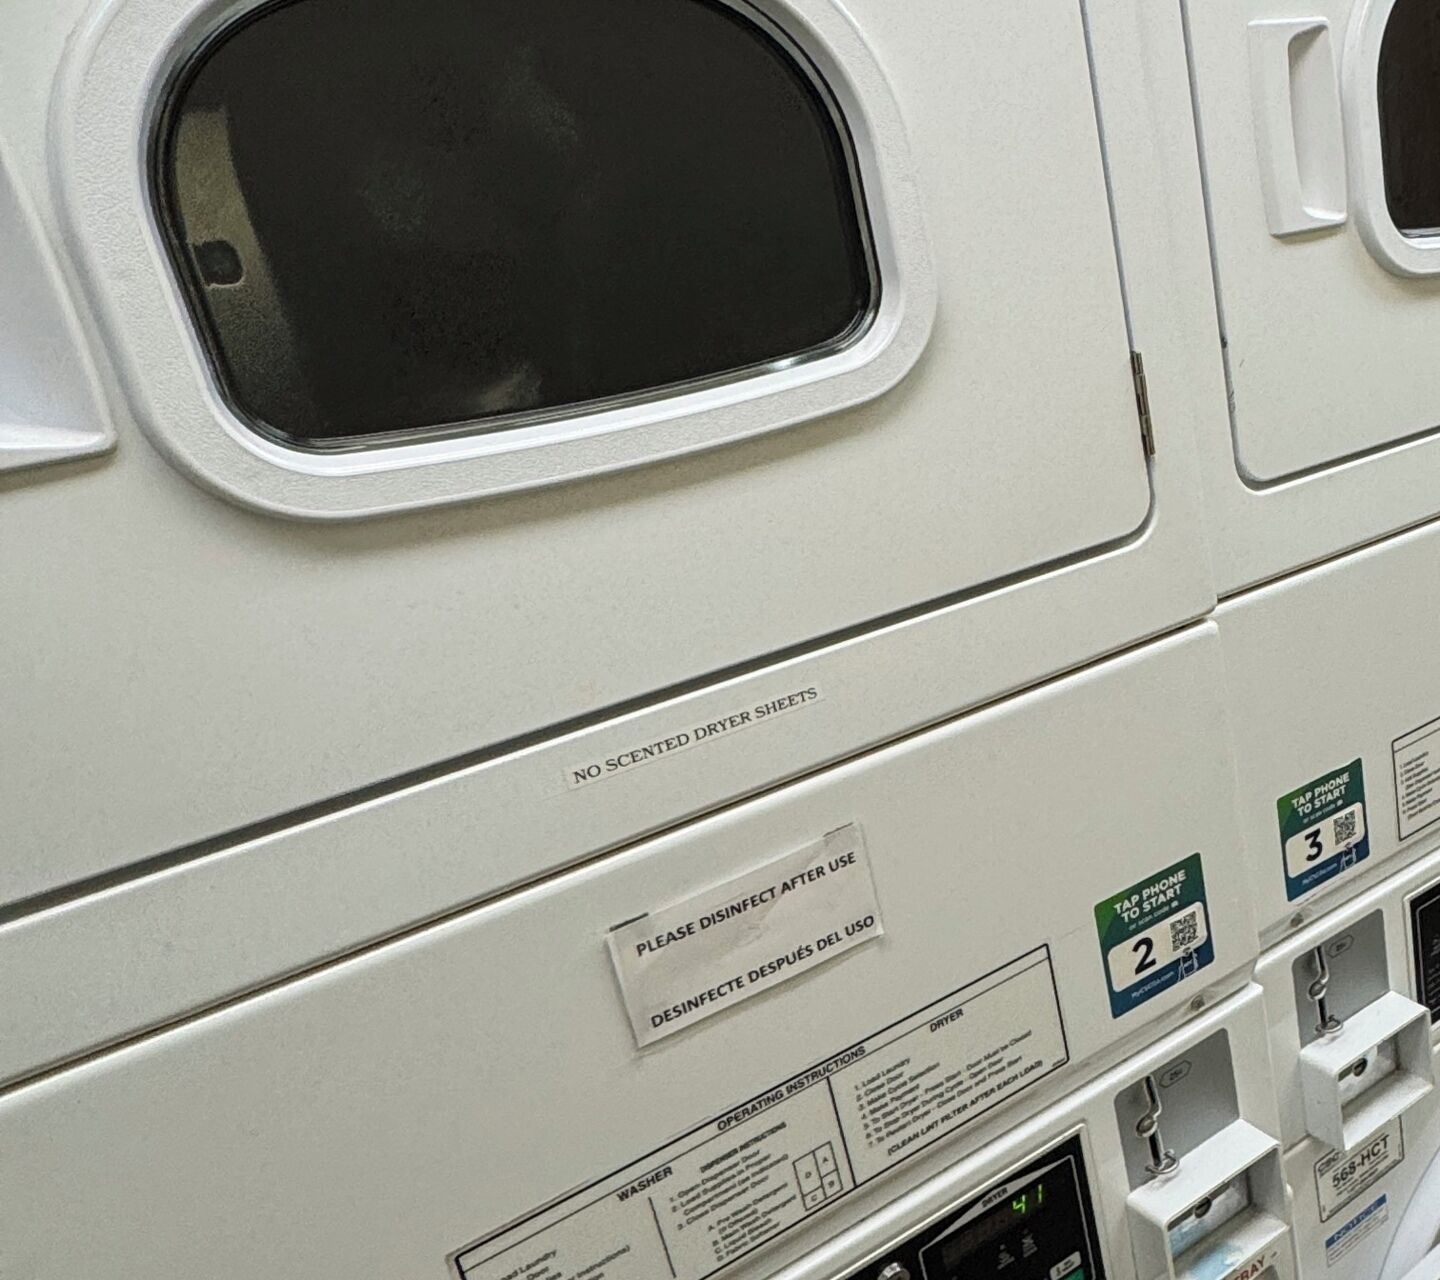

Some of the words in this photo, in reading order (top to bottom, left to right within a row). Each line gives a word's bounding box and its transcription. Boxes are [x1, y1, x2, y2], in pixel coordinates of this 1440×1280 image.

[573, 765, 602, 784] NO
[605, 733, 690, 772] SCENTED
[694, 711, 752, 742] DRYER
[754, 687, 819, 719] SHEETS
[1292, 791, 1312, 808] TAP
[1314, 772, 1350, 796] PHONE
[1297, 805, 1312, 816] TO
[1314, 785, 1346, 808] START
[1304, 828, 1323, 861] 3
[636, 922, 696, 957] PLEASE
[700, 887, 777, 930] DISINFECT
[780, 865, 826, 895] AFTER
[828, 851, 857, 873] USE
[1114, 894, 1139, 915] TAP
[1142, 869, 1186, 900] PHONE
[1120, 909, 1140, 923] TO
[1143, 883, 1183, 912] START
[650, 976, 745, 1028] DESINFECTE
[748, 944, 814, 983] DESPUÉS
[816, 930, 843, 952] DEL
[844, 915, 875, 938] USO
[1132, 937, 1156, 975] 2
[929, 1009, 964, 1032] DRYER
[717, 1089, 784, 1131] OPERATING
[785, 1046, 866, 1092] INSTRUCTIONS
[1332, 1134, 1389, 1188] 568-HCT
[616, 1166, 673, 1203] WASHER
